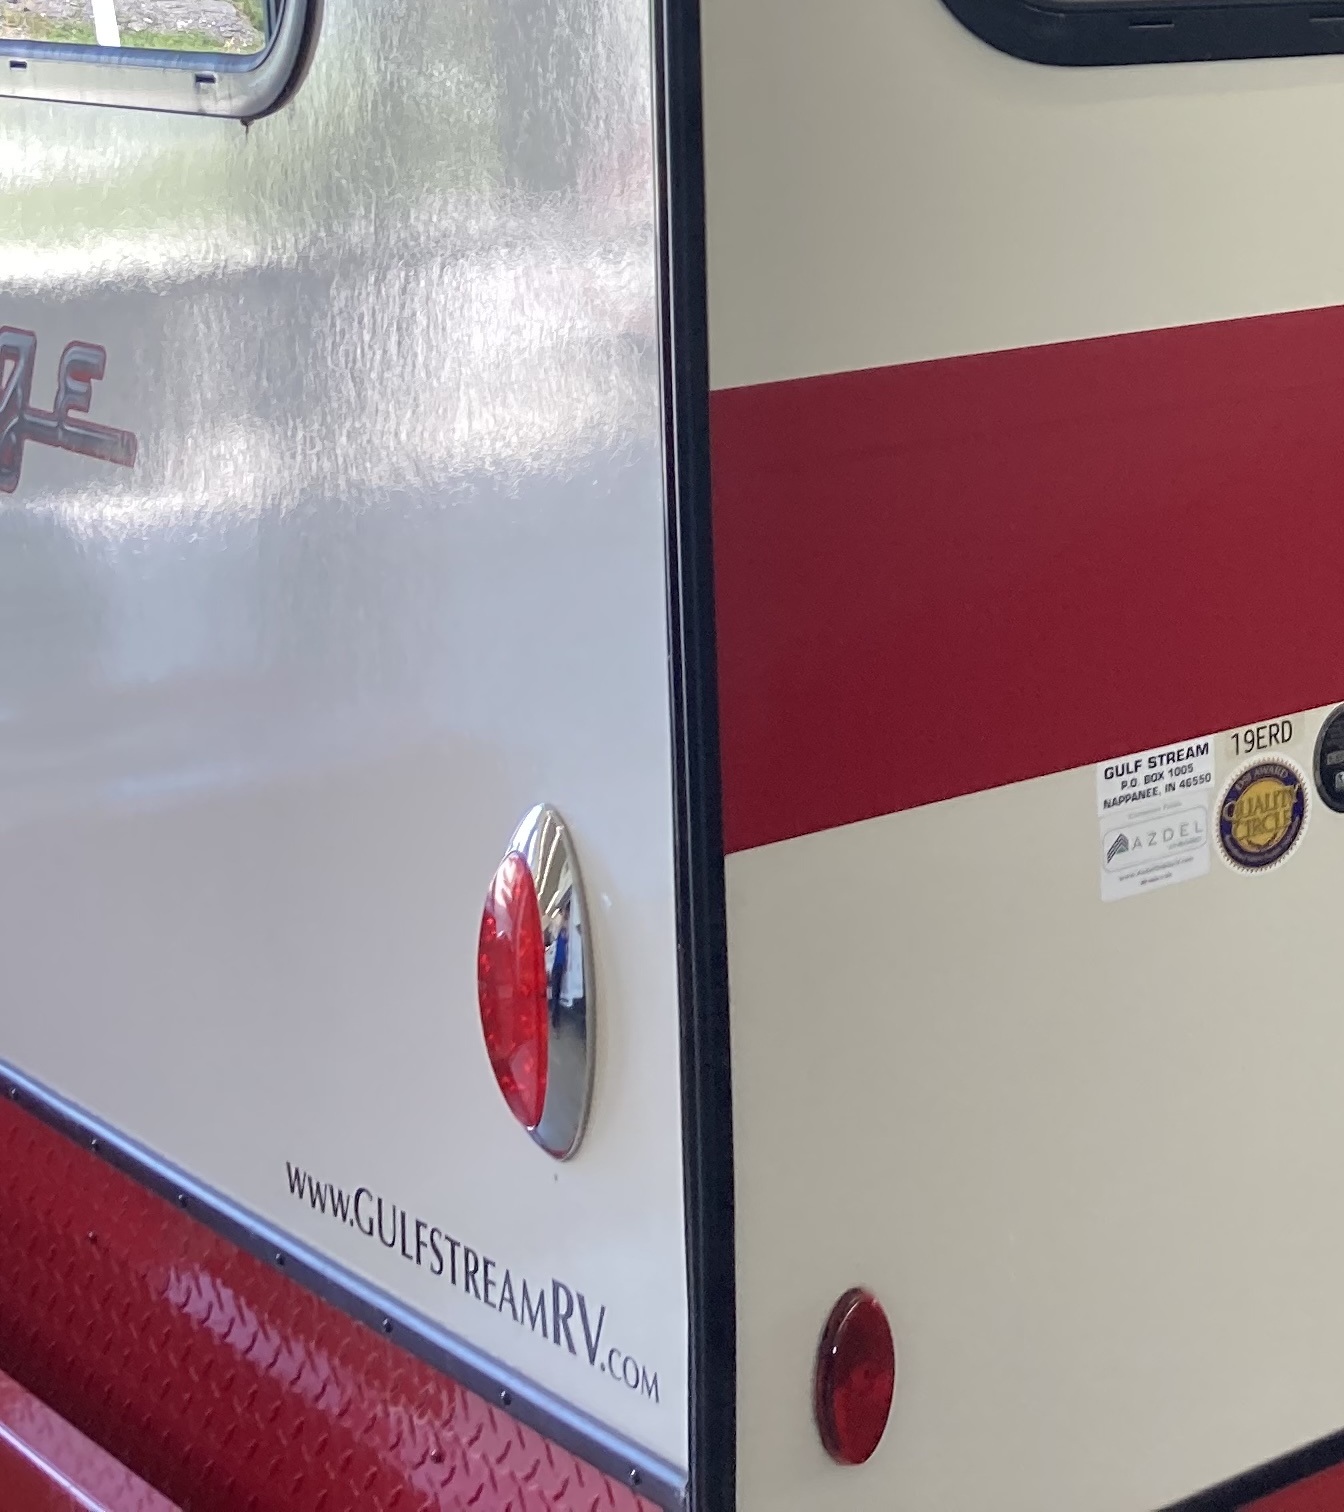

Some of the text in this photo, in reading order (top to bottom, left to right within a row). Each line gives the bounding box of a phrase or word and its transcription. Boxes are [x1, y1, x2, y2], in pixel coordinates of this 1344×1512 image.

[1230, 720, 1294, 757] 19ERD
[1103, 741, 1210, 781] GULF STREAM
[1143, 770, 1165, 785] BOX
[1164, 781, 1177, 794] IN
[1223, 783, 1301, 821] QUALITY
[1131, 820, 1204, 852] AZDEL
